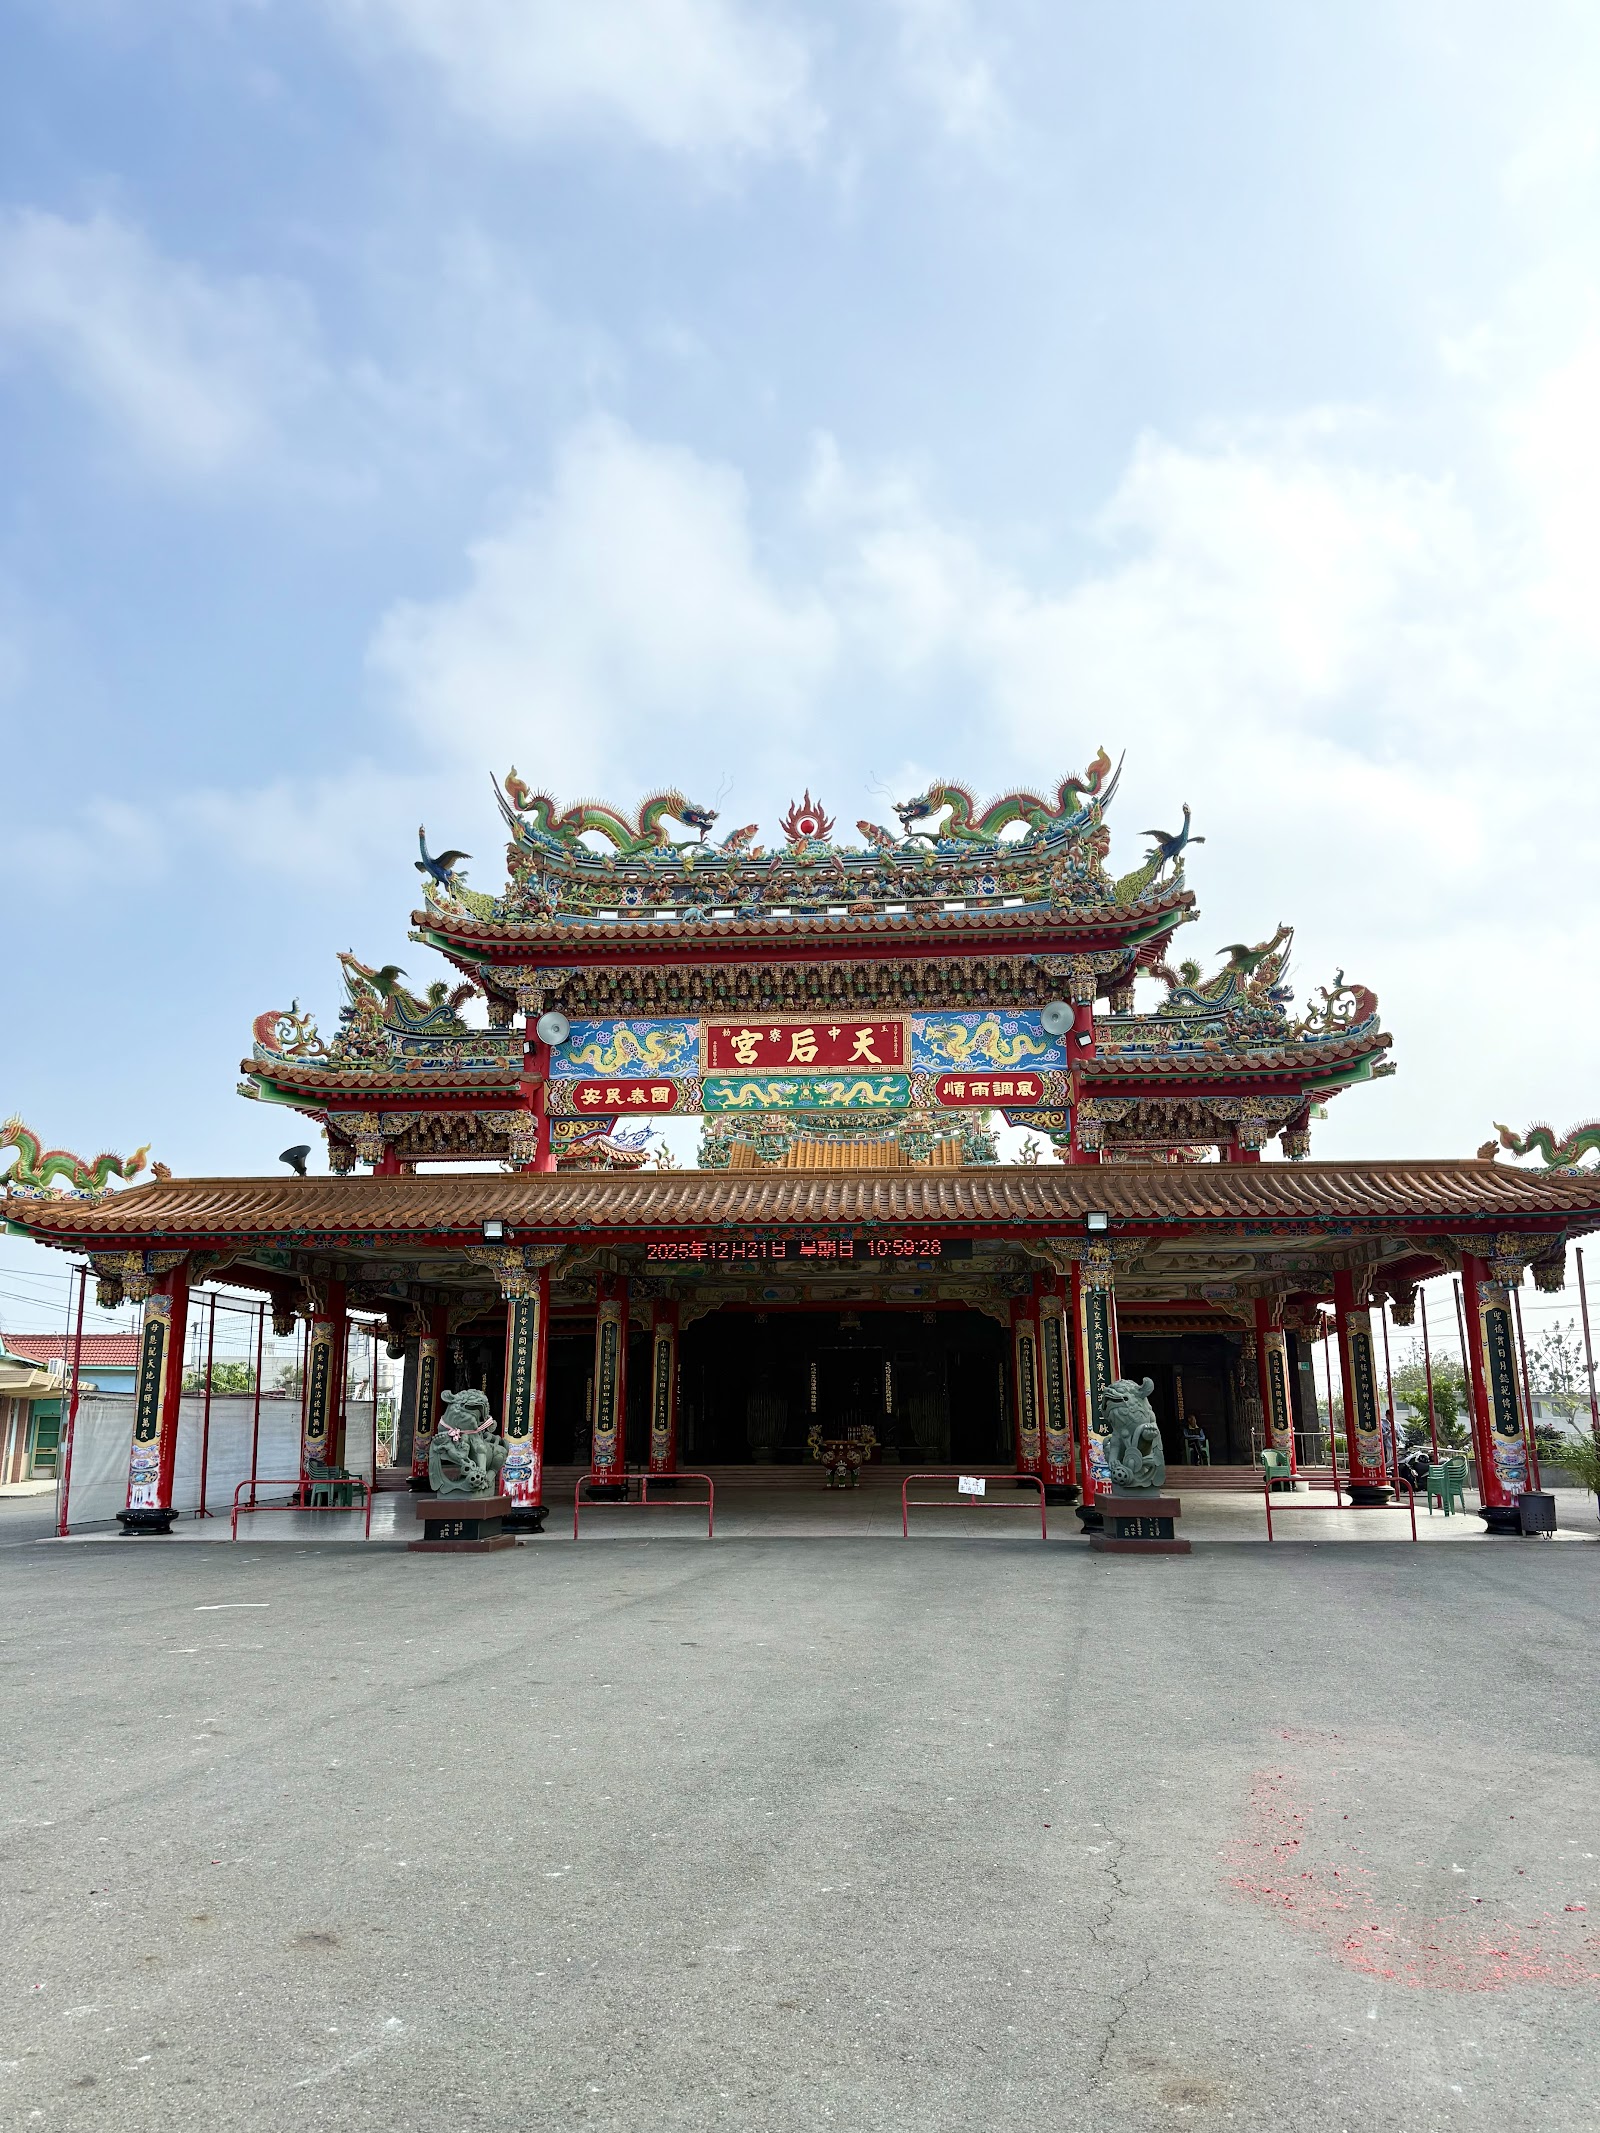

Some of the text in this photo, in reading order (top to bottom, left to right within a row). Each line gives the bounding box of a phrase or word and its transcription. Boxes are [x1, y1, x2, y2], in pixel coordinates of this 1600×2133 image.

[827, 1026, 841, 1042] 中
[730, 1027, 883, 1065] 天后宮
[580, 1086, 670, 1105] 國泰民安
[943, 1081, 1037, 1098] 風調雨順
[647, 1240, 786, 1261] 2025年12月21日
[867, 1239, 942, 1256] 10:59:28
